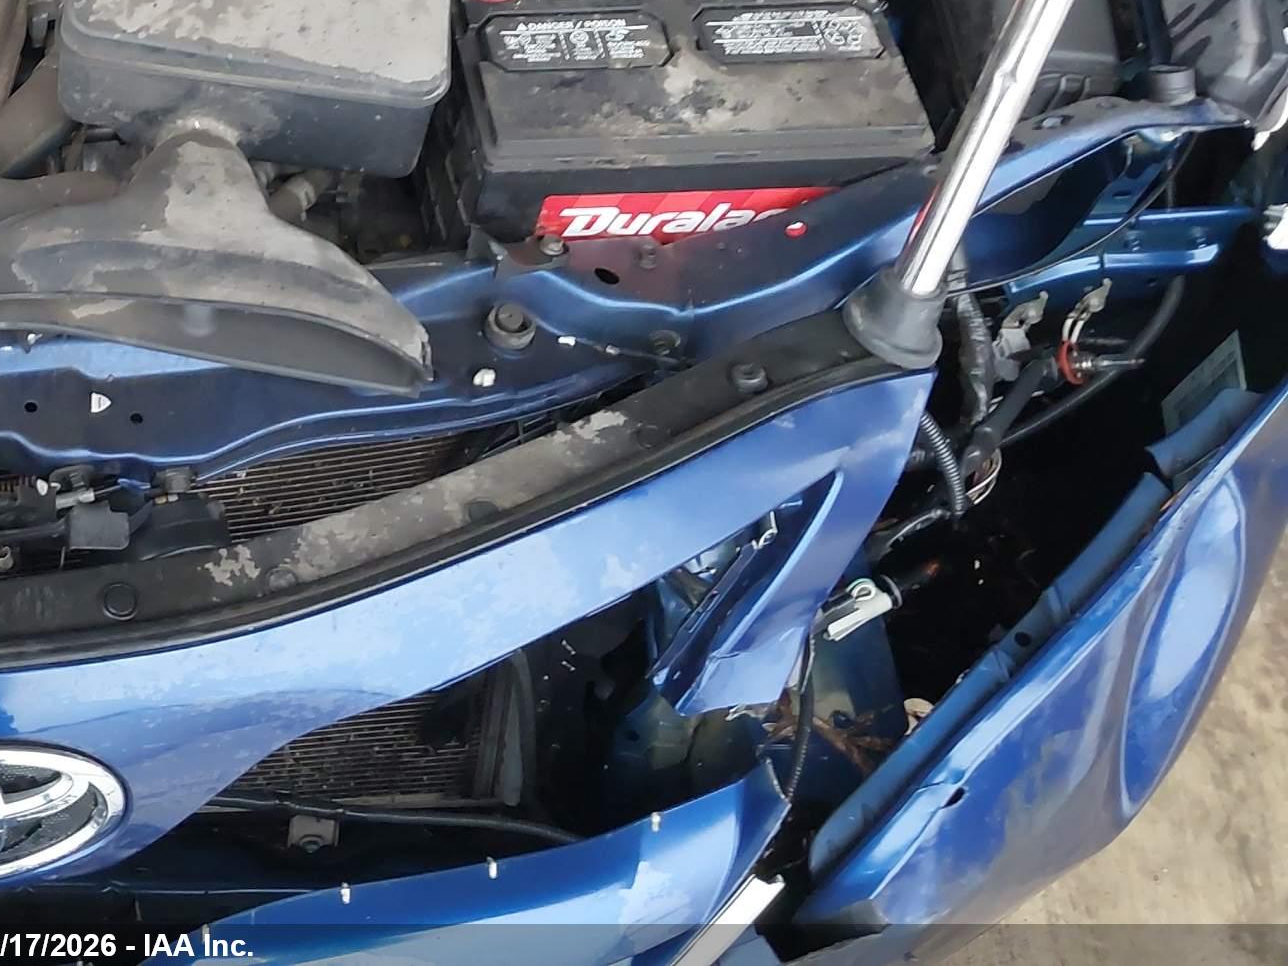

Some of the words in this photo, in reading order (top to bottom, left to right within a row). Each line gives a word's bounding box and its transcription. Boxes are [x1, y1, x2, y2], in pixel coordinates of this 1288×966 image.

[528, 21, 574, 31] DANGER
[584, 19, 626, 29] POISON
[560, 202, 790, 237] Durala
